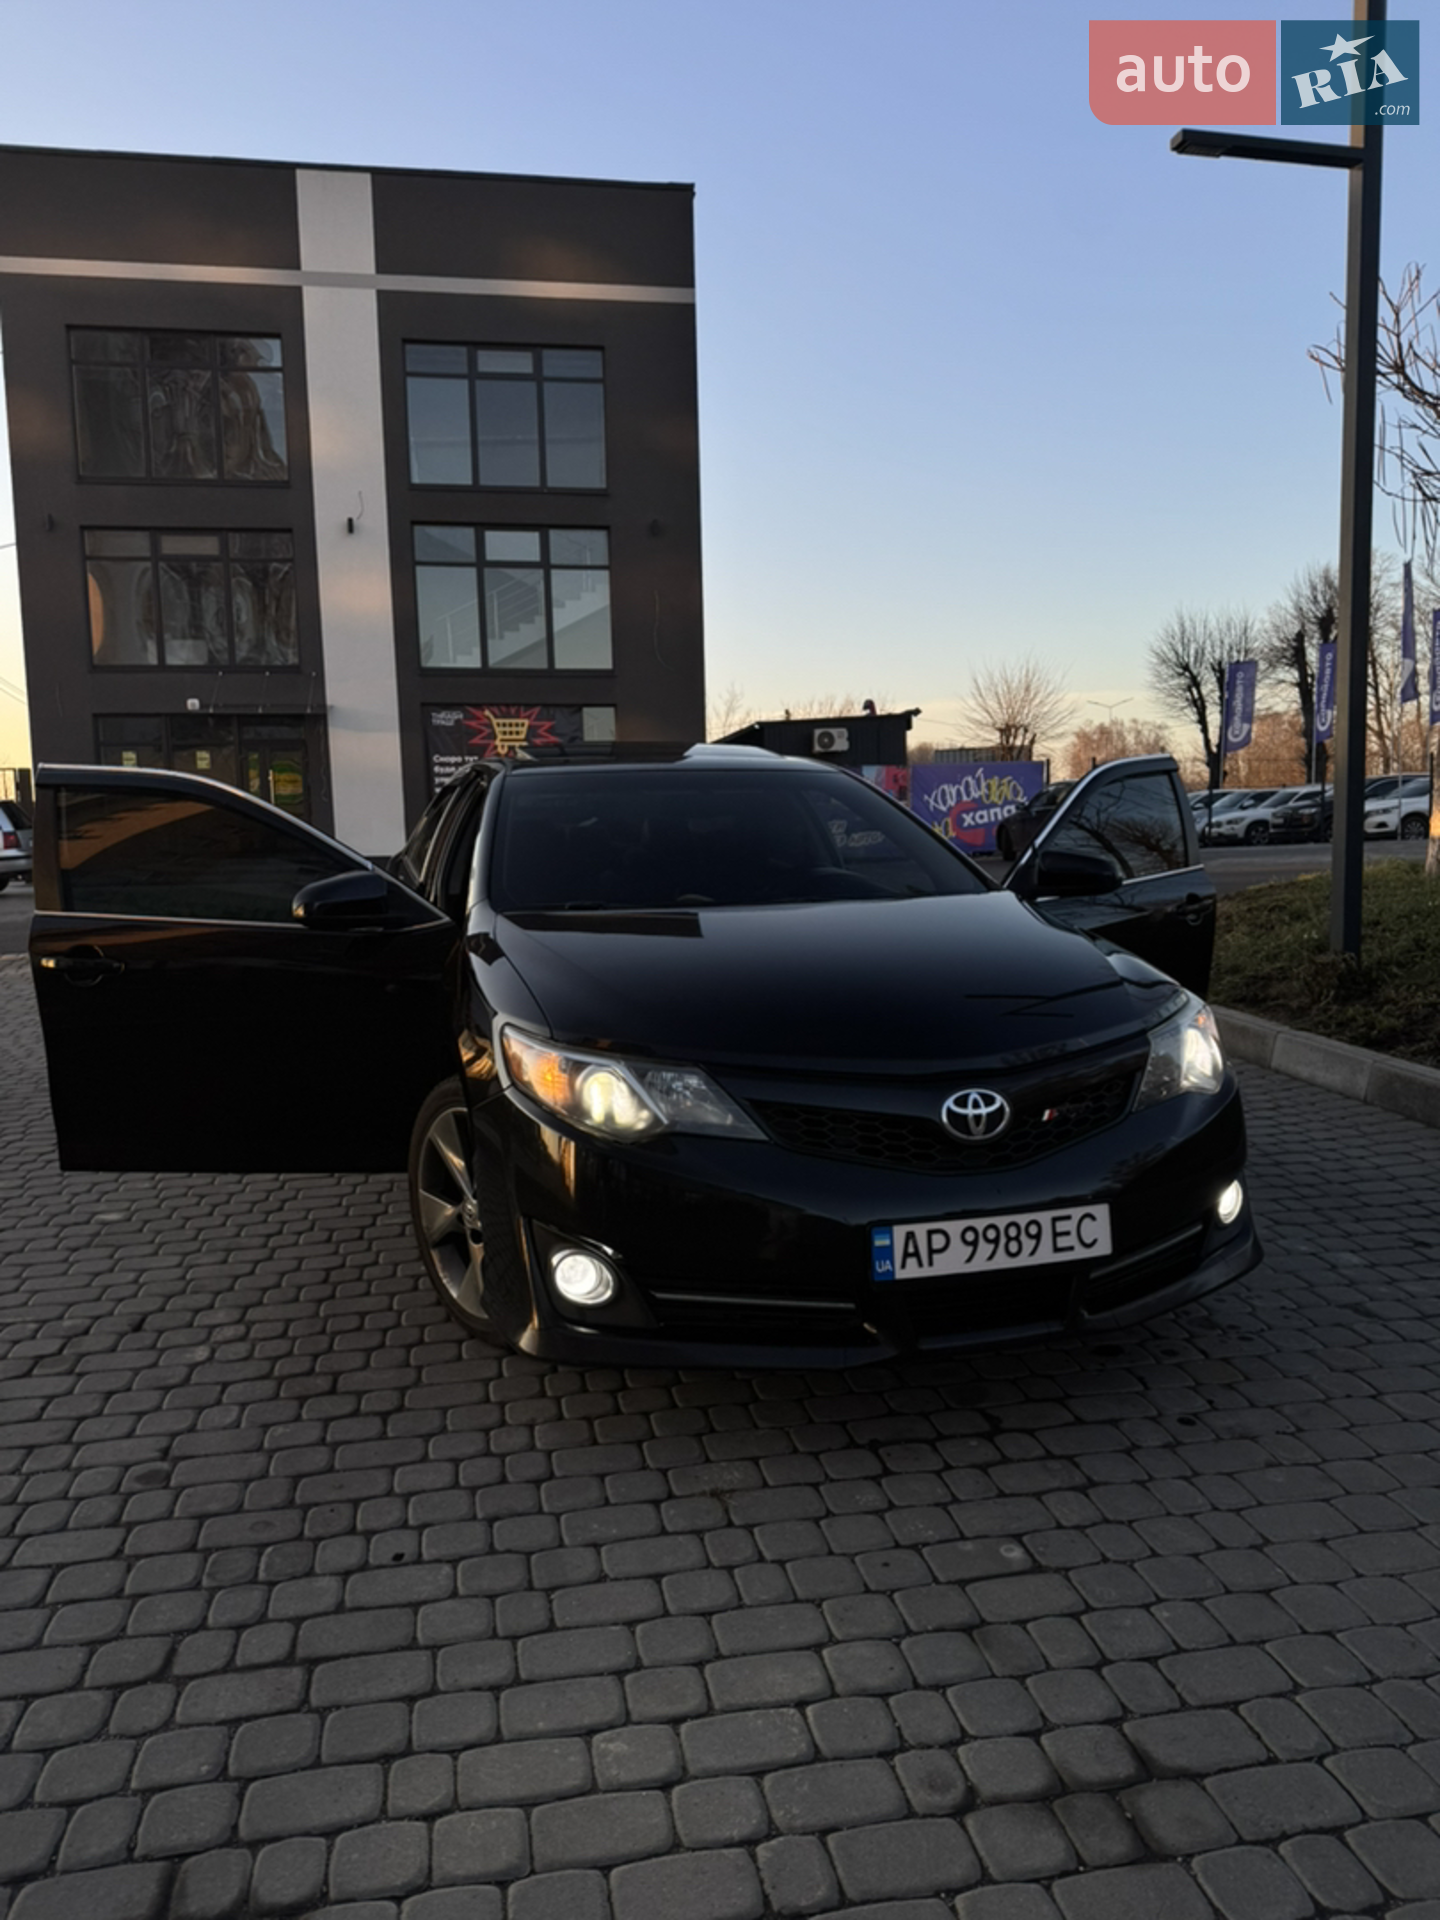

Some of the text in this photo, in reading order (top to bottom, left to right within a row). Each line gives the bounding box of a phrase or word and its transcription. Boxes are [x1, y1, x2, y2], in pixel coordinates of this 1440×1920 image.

[962, 804, 1020, 828] хапа
[900, 1212, 1099, 1270] AP 9989 EC
[875, 1260, 893, 1273] UA
